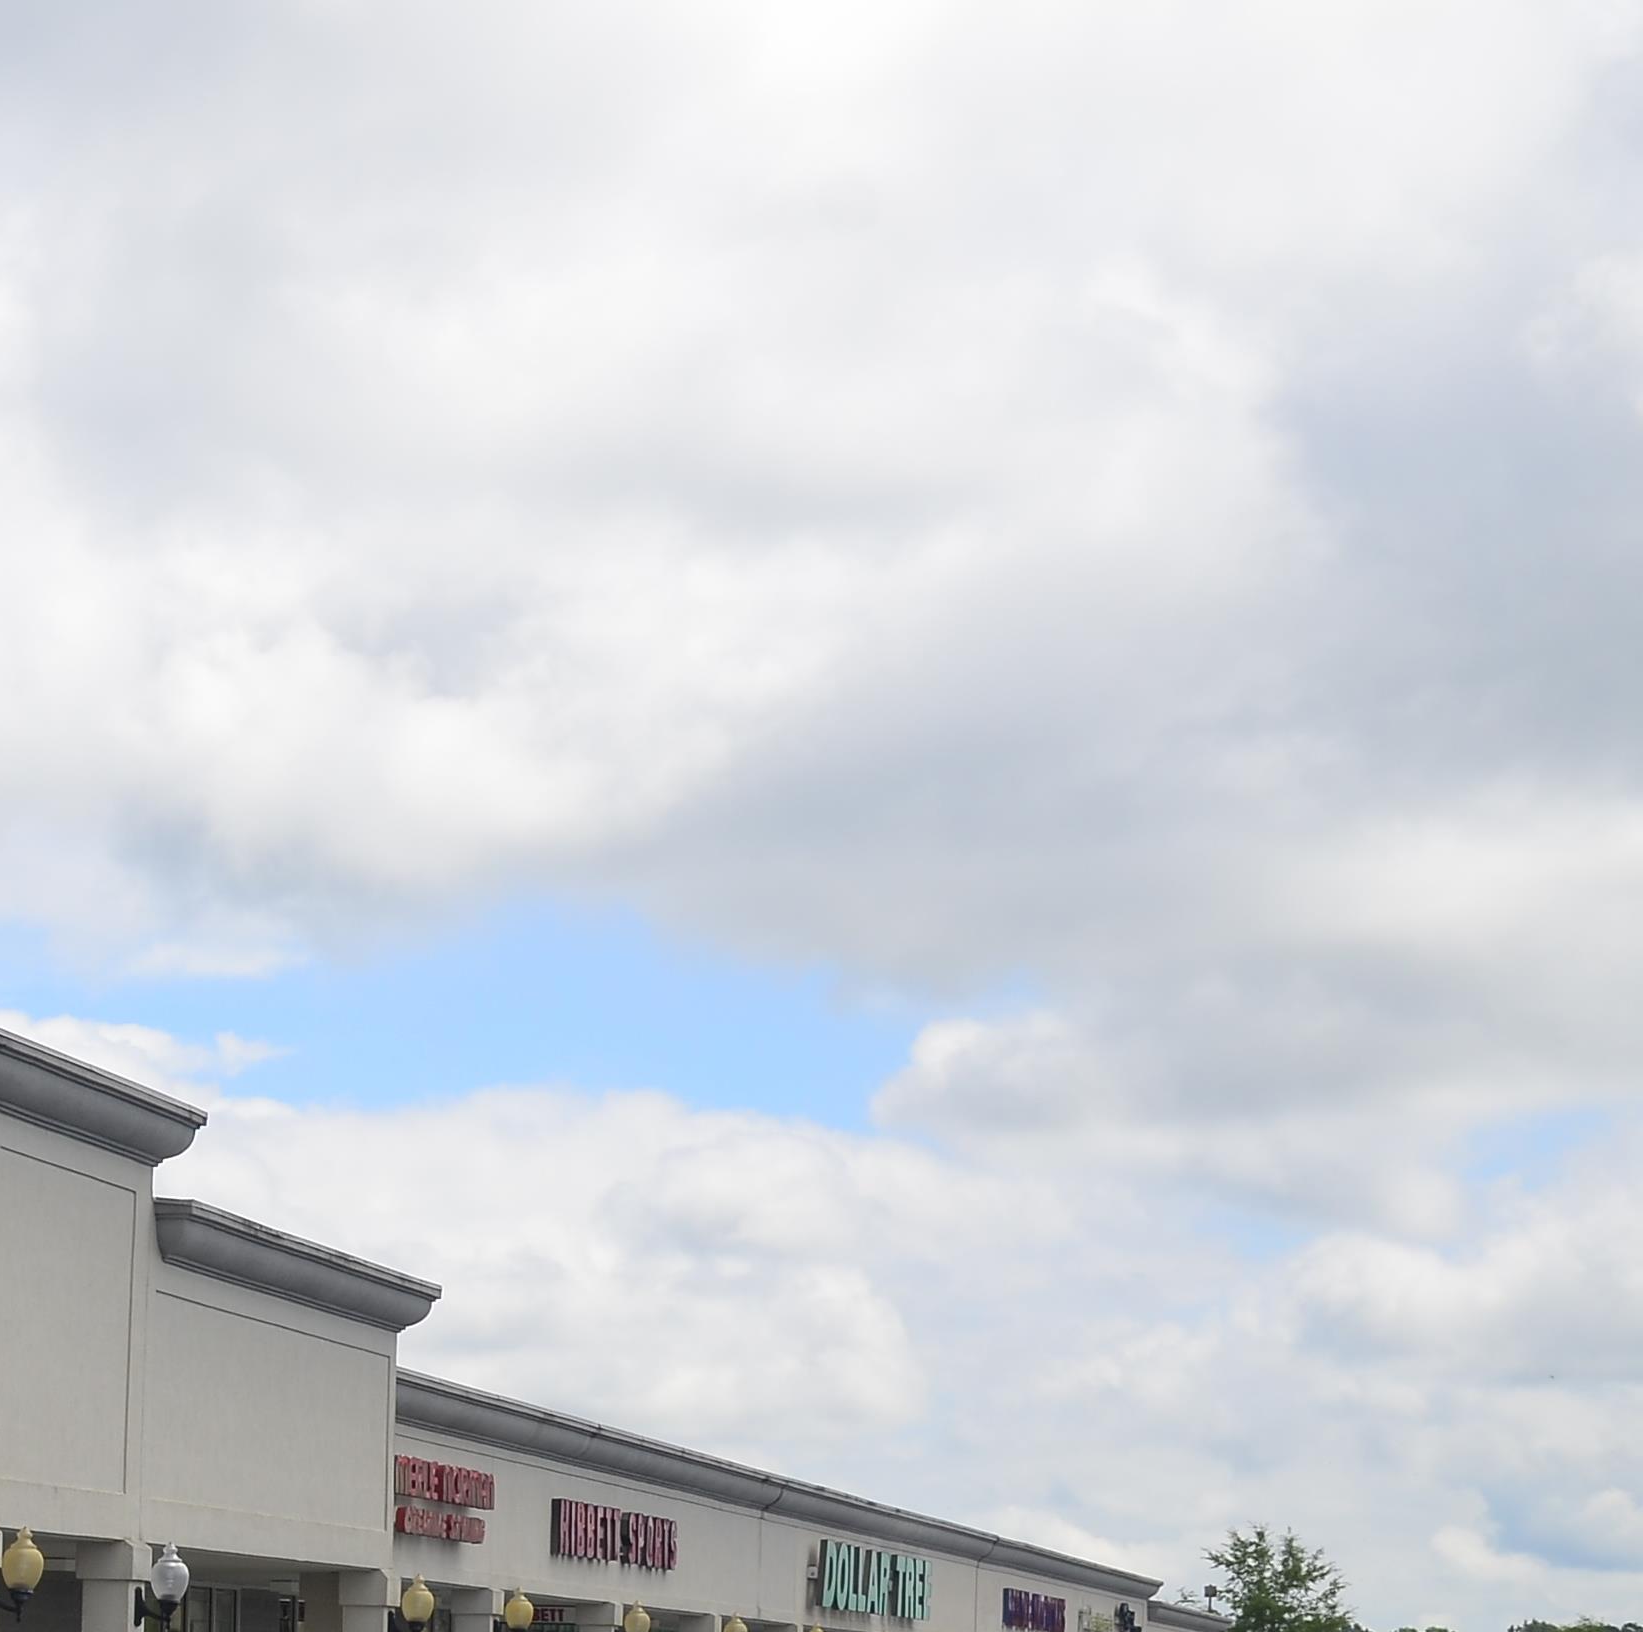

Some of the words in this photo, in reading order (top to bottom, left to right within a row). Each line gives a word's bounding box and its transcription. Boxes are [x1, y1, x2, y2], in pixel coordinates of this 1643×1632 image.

[551, 1498, 621, 1562] HIBBETT
[621, 1511, 677, 1571] SPORTS
[534, 1607, 564, 1622] BETT
[817, 1539, 892, 1617] DOLLAR
[892, 1554, 932, 1621] TREE
